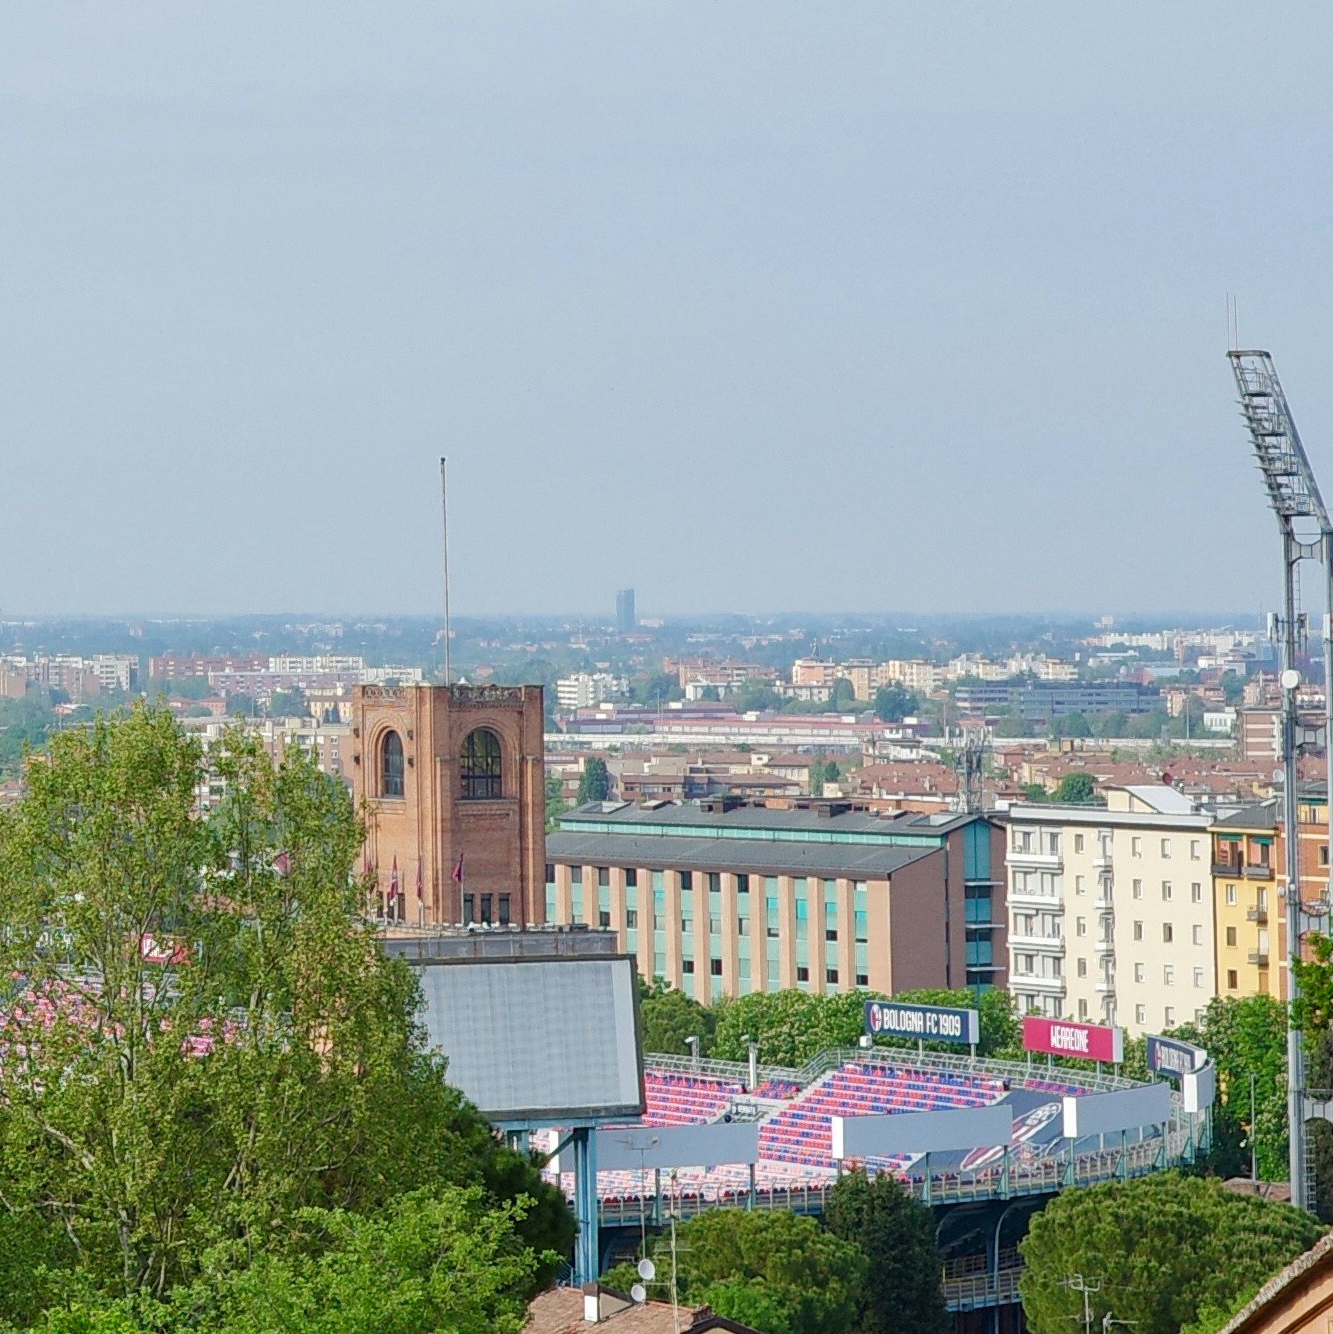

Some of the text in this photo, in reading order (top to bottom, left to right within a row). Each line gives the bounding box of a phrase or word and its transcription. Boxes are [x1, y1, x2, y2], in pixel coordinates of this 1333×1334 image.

[883, 1008, 961, 1037] BOLOGNA FC 1909
